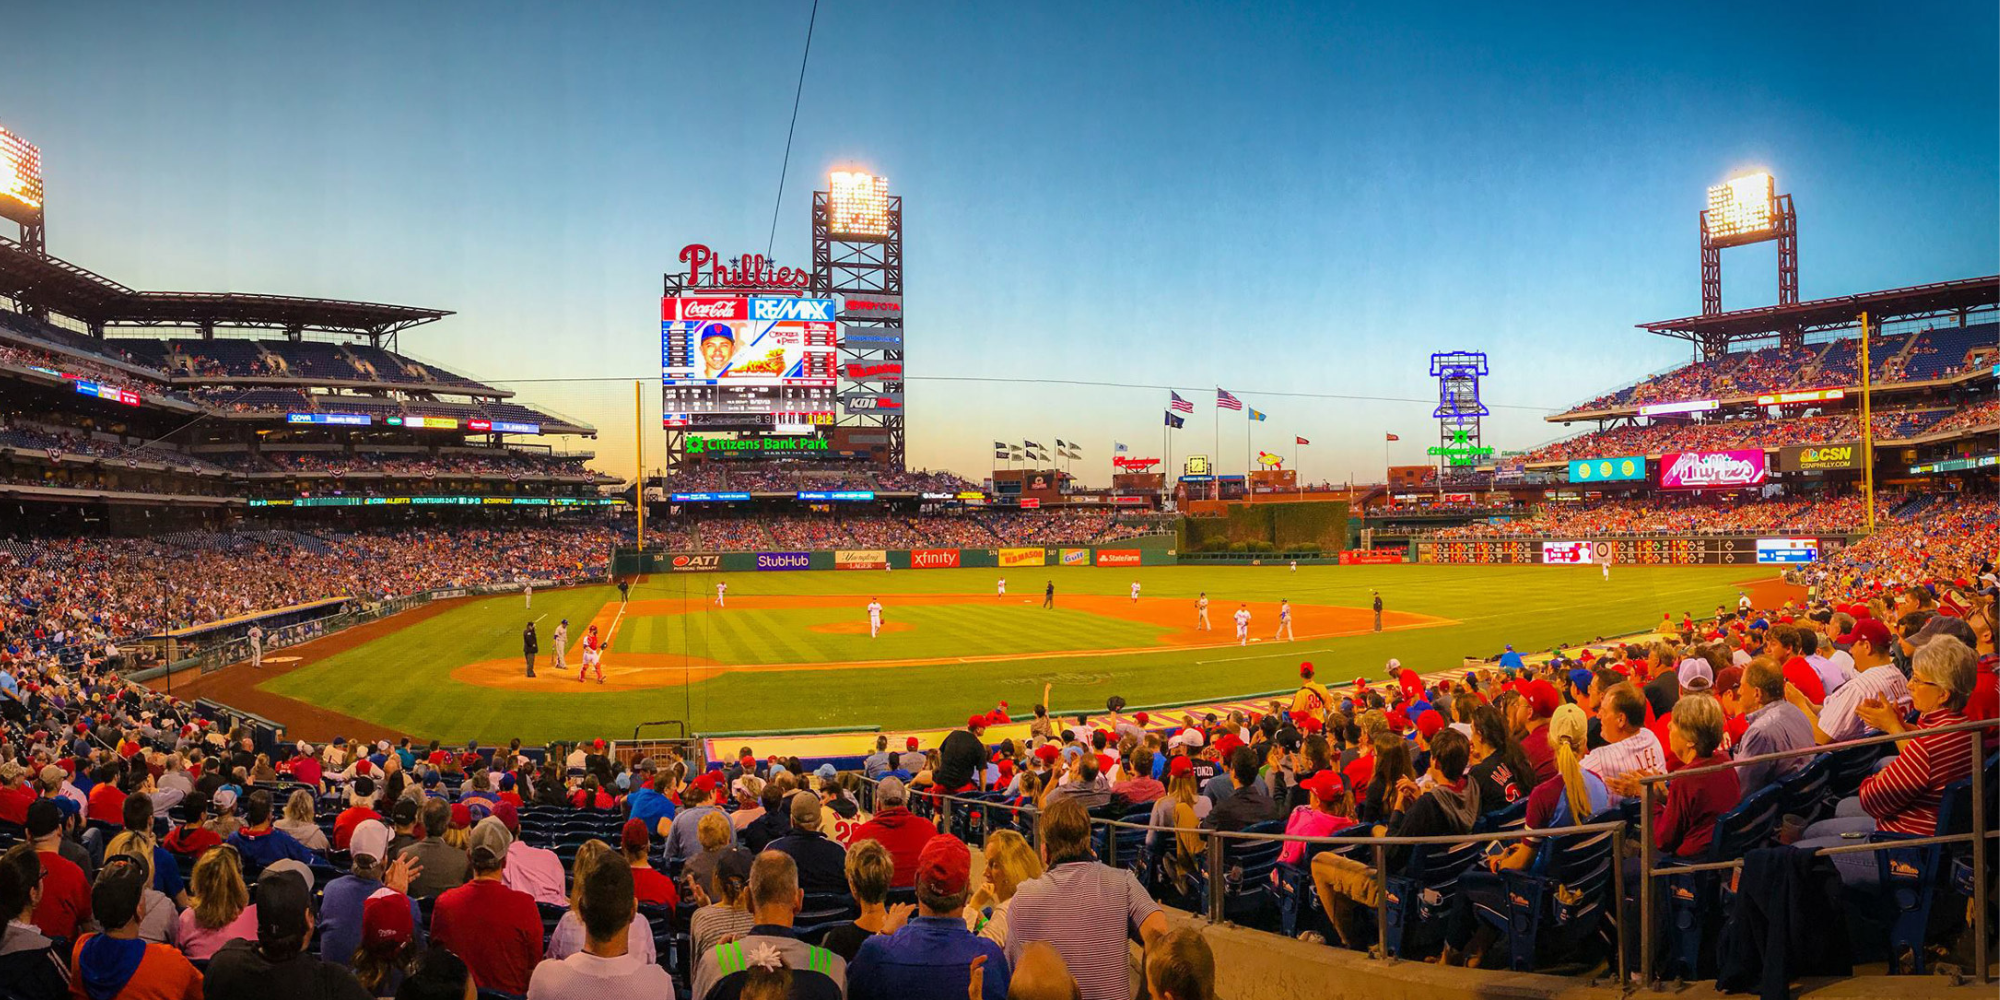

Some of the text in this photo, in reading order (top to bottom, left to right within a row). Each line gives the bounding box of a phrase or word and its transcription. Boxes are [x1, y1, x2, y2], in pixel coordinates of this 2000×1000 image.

[679, 244, 810, 286] Phillies
[685, 300, 738, 318] Coca-Cola
[755, 299, 829, 320] RE/MAX
[859, 301, 901, 311] TOYOTA
[707, 437, 828, 450] Citizens Bank Park
[1819, 447, 1851, 461] CSN
[1800, 461, 1851, 469] CSNPHILLY.COM
[688, 555, 720, 566] ATI
[758, 555, 809, 567] StubHub
[915, 551, 956, 567] xfinity
[1064, 552, 1084, 562] Gulf
[1635, 747, 1657, 771] LEE
